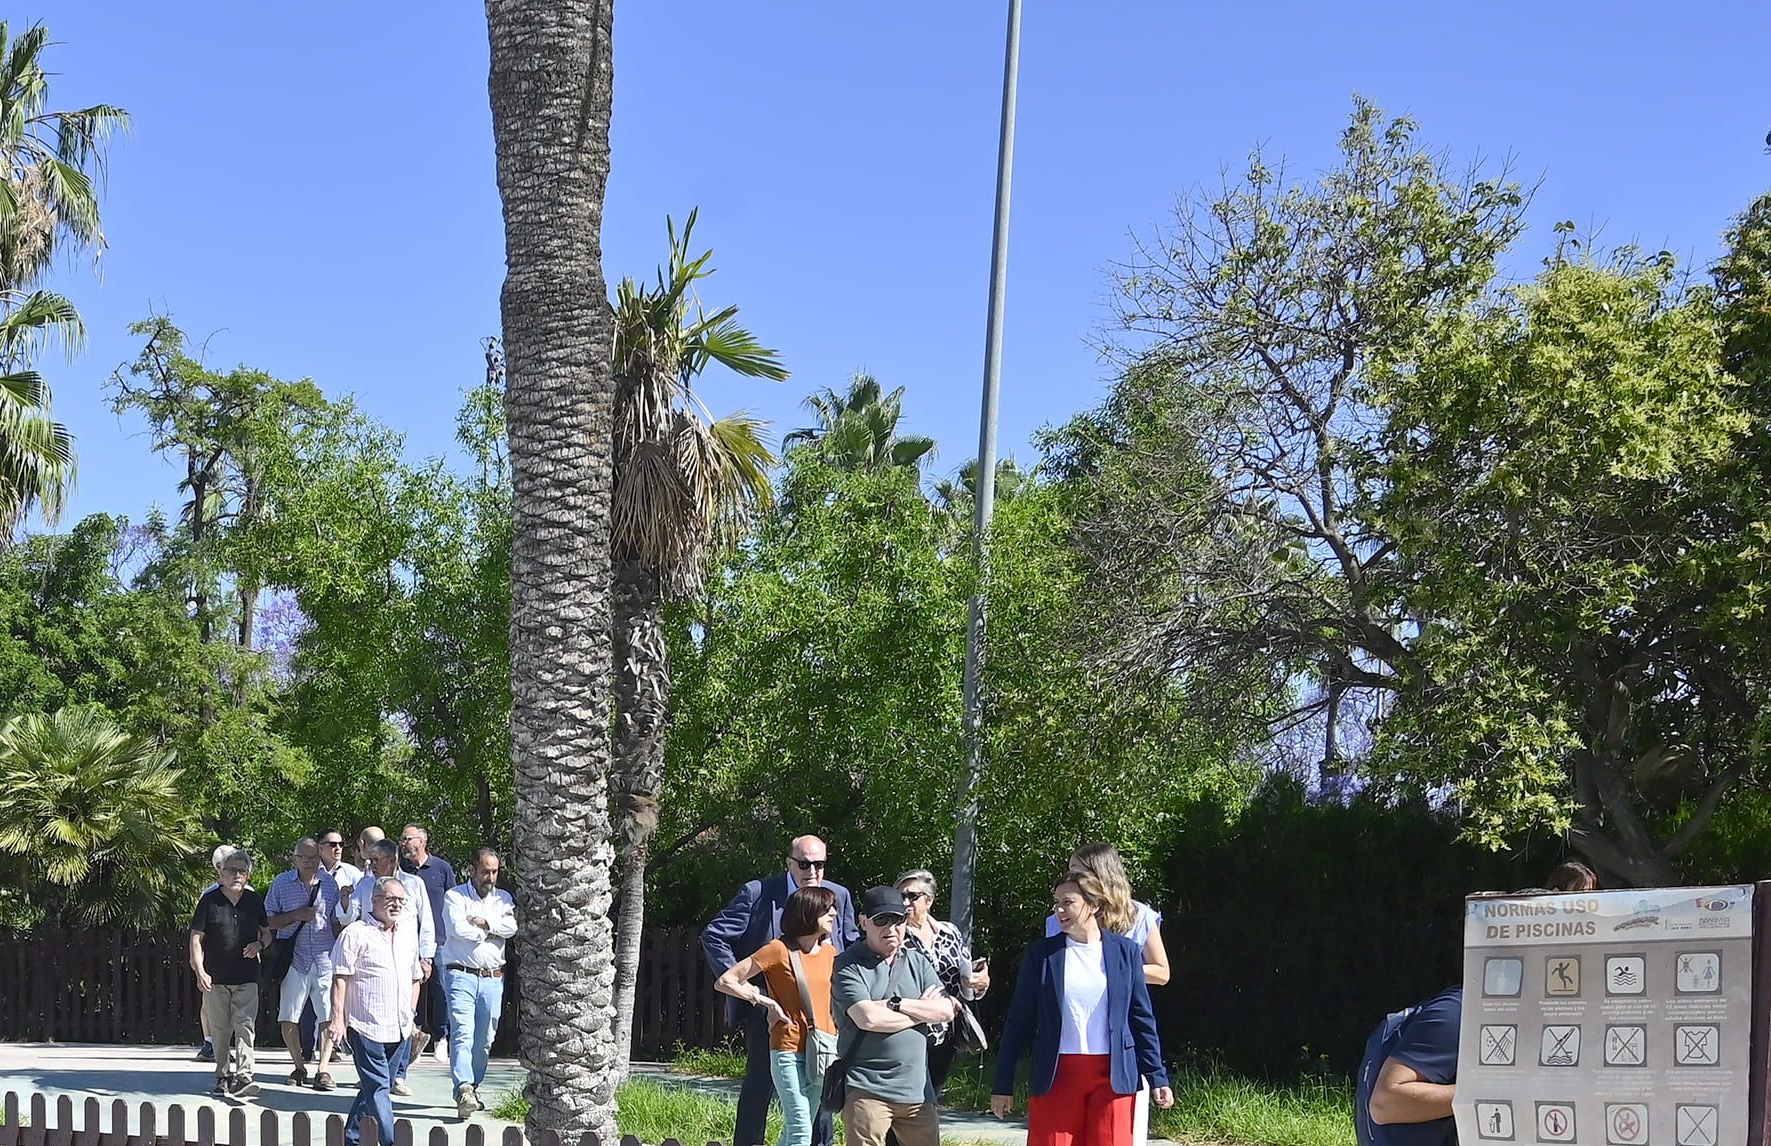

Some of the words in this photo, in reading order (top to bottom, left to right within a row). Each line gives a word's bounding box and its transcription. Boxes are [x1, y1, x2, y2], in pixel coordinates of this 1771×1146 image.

[1485, 903, 1556, 918] NORMAS
[1562, 899, 1598, 914] USO
[1486, 925, 1510, 939] DE
[1516, 920, 1596, 938] PISCINAS
